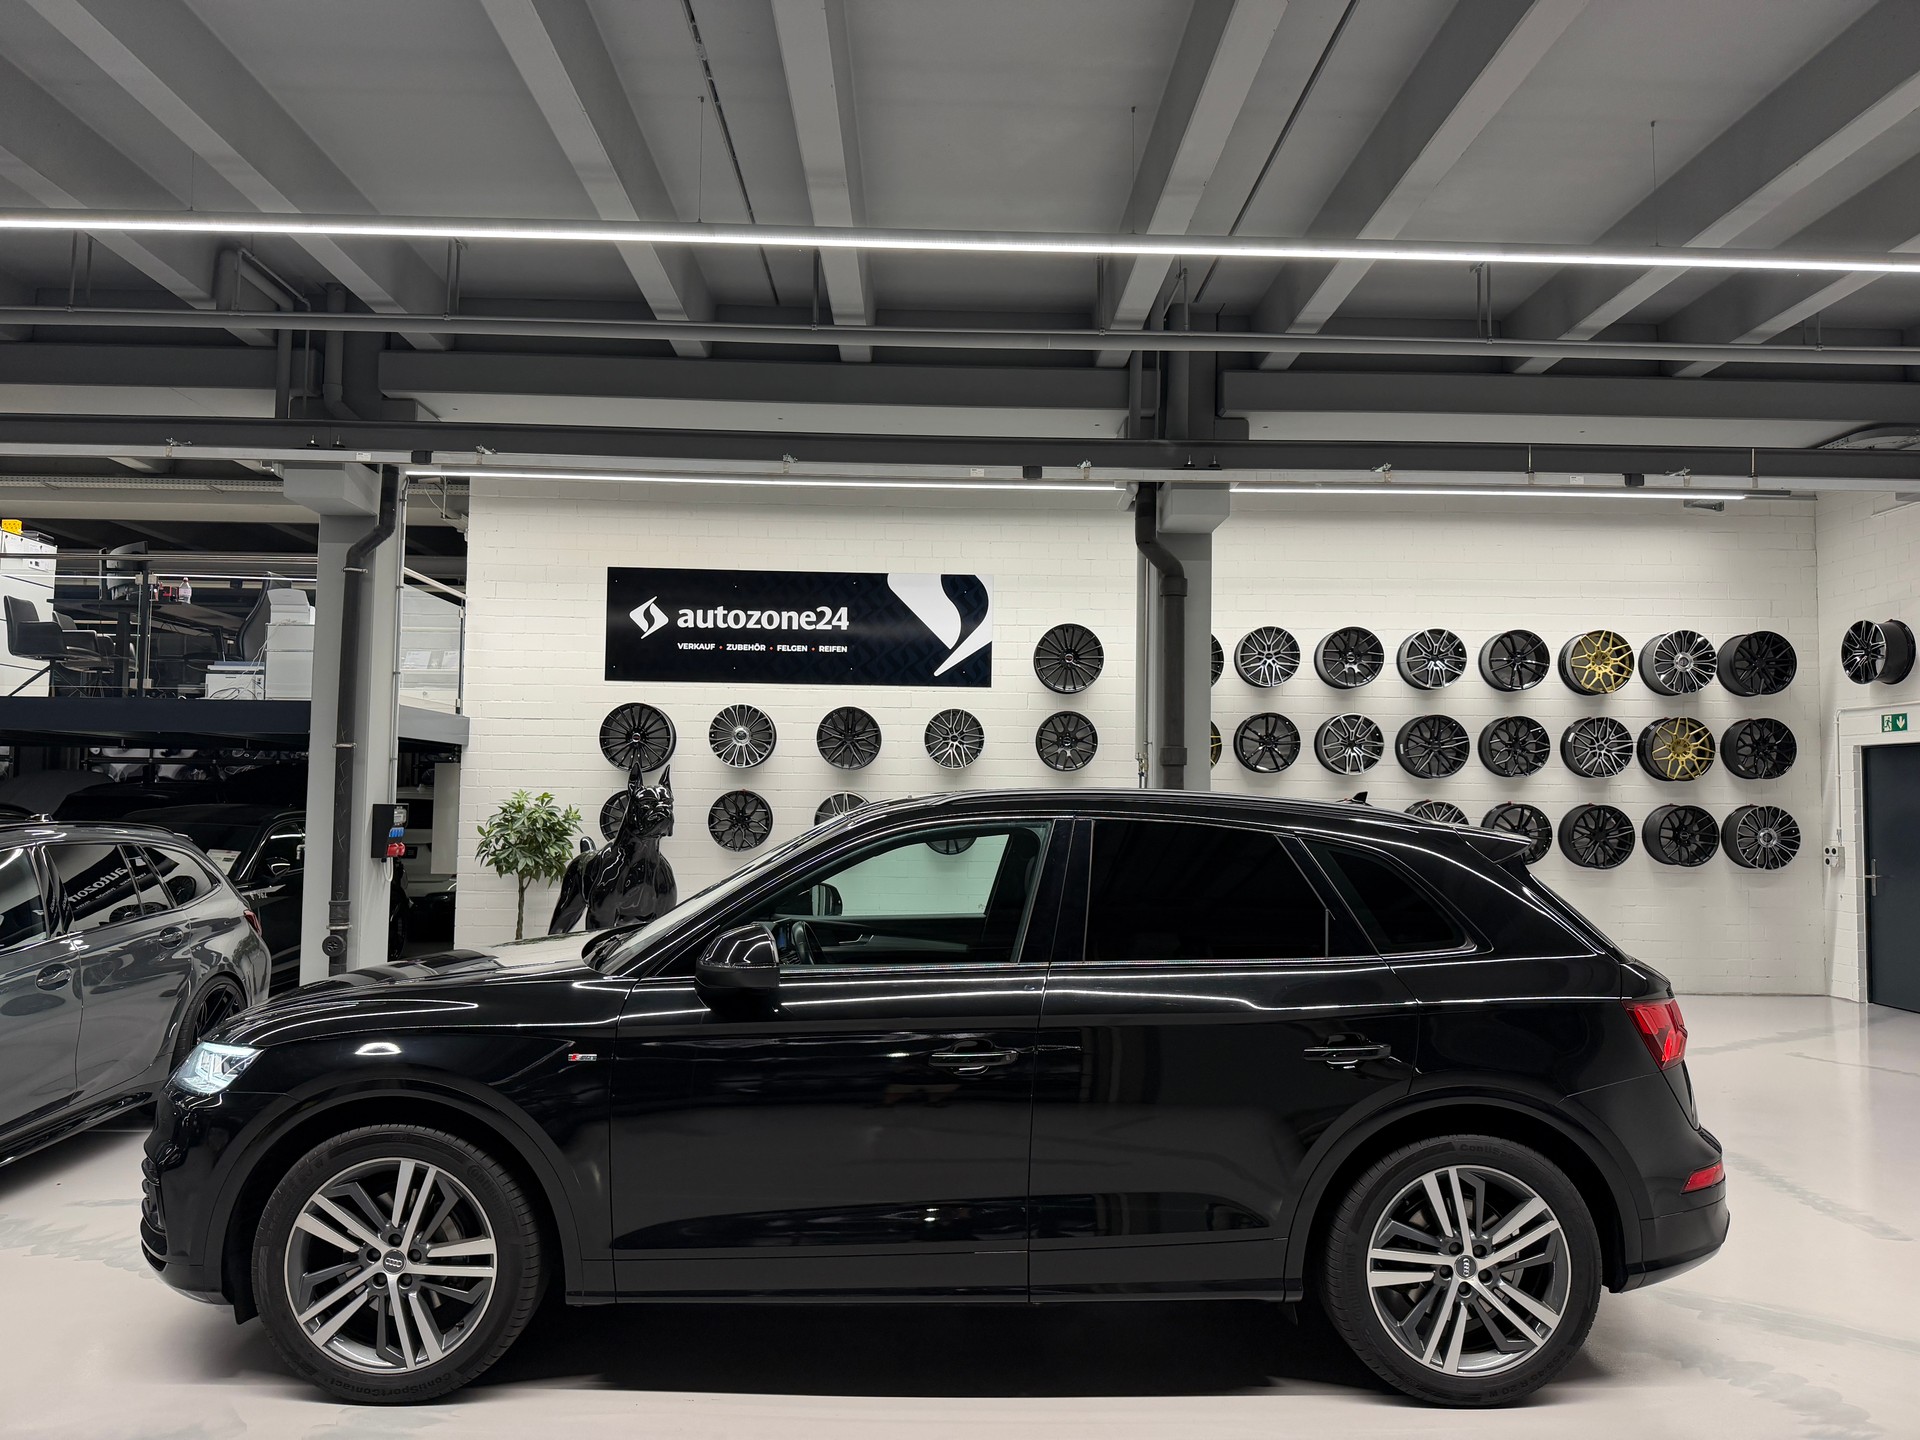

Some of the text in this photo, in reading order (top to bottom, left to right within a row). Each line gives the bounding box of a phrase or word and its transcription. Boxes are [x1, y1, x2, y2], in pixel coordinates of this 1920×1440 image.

[677, 605, 849, 630] autozone24
[677, 642, 848, 653] VERKAUF ZUBEHÖR FELGEN REIFEN
